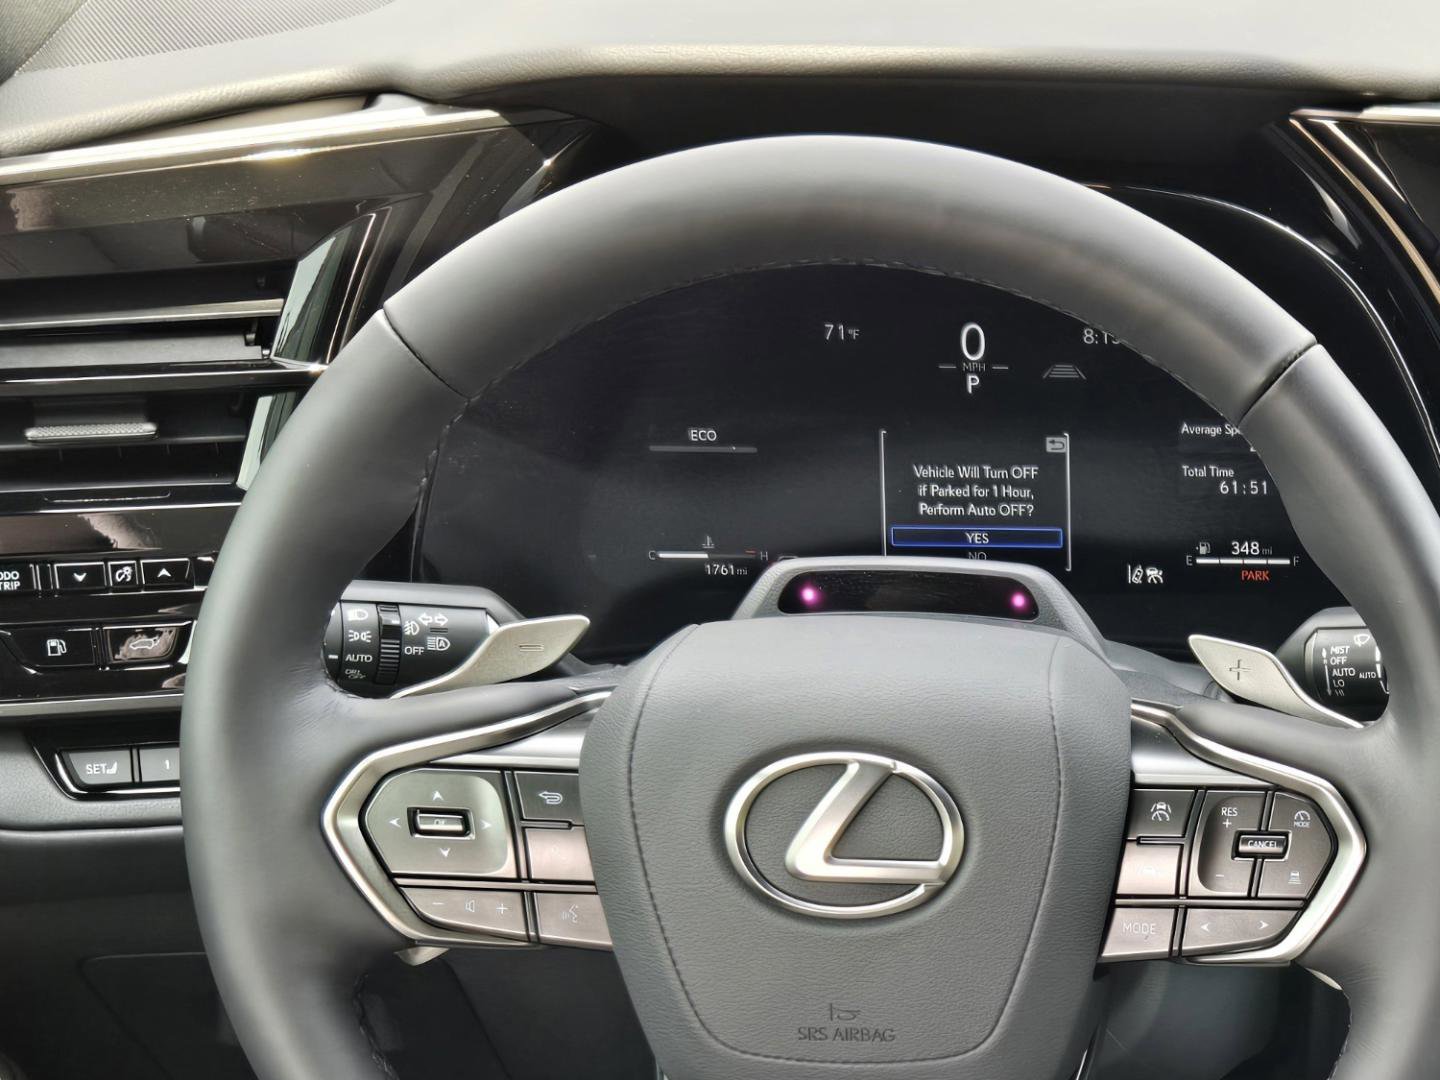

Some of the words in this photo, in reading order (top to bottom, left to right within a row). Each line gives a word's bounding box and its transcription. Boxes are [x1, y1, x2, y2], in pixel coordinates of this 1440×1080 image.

[960, 322, 986, 361] 0
[962, 362, 986, 372] MPH
[967, 374, 980, 394] P
[1181, 423, 1222, 436] Average
[690, 430, 717, 442] ECO
[913, 464, 955, 478] Vehicle
[958, 466, 980, 479] Will
[983, 466, 1008, 479] Turn
[1012, 466, 1039, 479] OFF
[1182, 464, 1207, 477] Total
[1210, 466, 1234, 478] Time
[918, 484, 928, 497] if
[931, 484, 970, 497] Parked
[973, 484, 989, 498] for
[992, 486, 998, 498] 1
[1002, 486, 1034, 500] Hour,
[1220, 480, 1268, 495] 61:51
[919, 502, 964, 516] Perform
[968, 504, 996, 516] Auto
[1000, 504, 1034, 517] OFF?
[966, 532, 989, 544] YES
[1231, 542, 1260, 556] 348
[648, 550, 656, 560] C
[760, 551, 768, 561] H
[1186, 556, 1193, 566] E
[705, 564, 734, 576] 1761
[1241, 570, 1270, 581] PARK
[404, 646, 425, 656] OFF
[1330, 646, 1350, 654] MIST
[345, 654, 373, 663] AUTO
[1330, 656, 1348, 666] OFF
[1332, 668, 1356, 677] AUTO
[1332, 680, 1345, 688] LO
[86, 764, 107, 774] SET
[165, 760, 170, 770] 1
[1222, 807, 1238, 817] RES
[1248, 840, 1277, 848] CANCEL
[1122, 922, 1156, 934] MODE
[798, 1026, 828, 1041] SRS
[832, 1028, 896, 1042] AIRBAG
